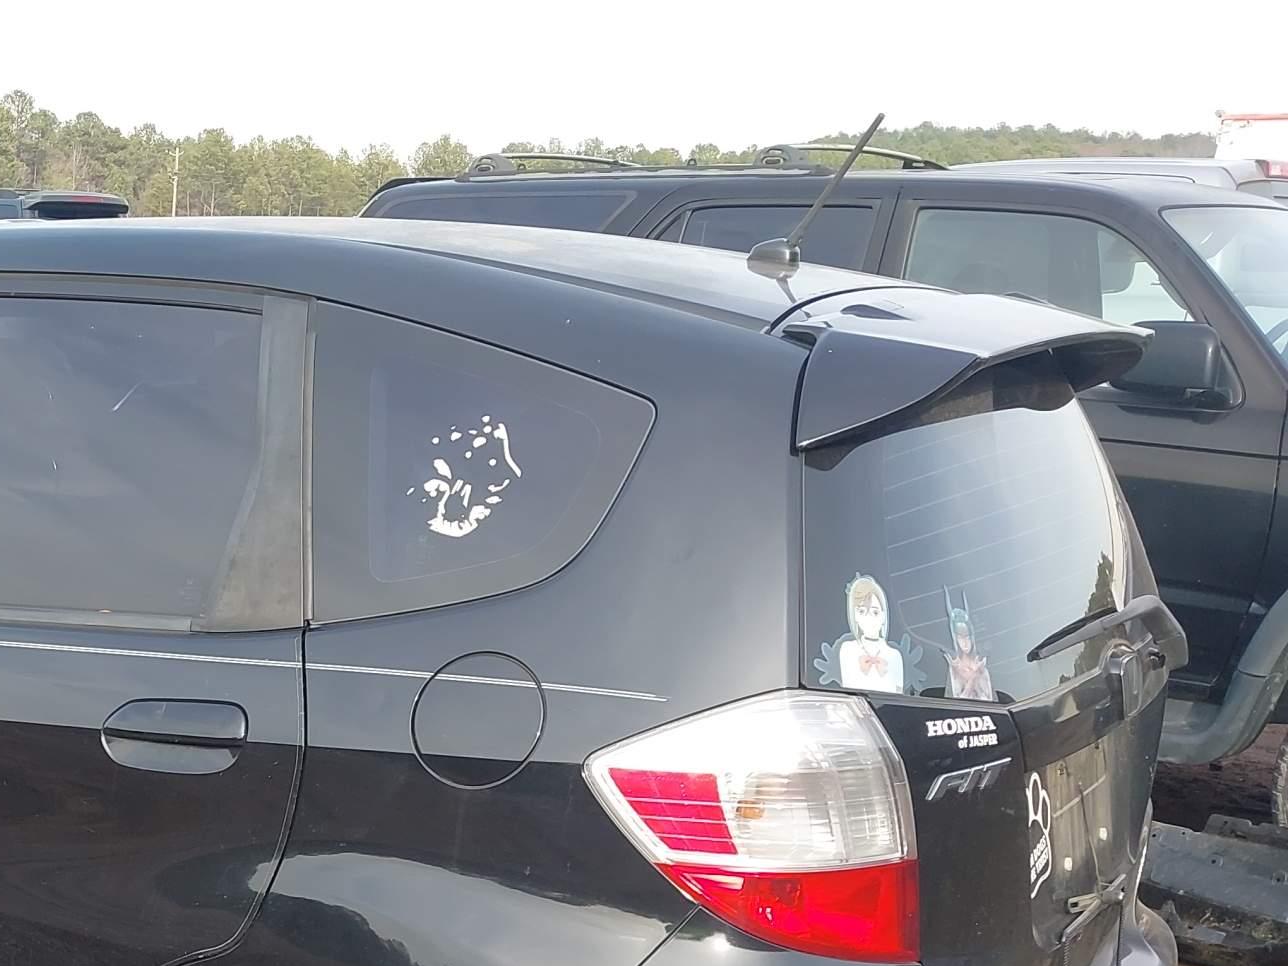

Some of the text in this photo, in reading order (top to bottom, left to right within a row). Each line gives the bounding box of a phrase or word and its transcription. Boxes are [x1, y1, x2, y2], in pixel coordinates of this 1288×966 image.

[925, 715, 997, 736] HONDA
[957, 733, 999, 749] of JASPER
[925, 757, 1012, 801] FIT
